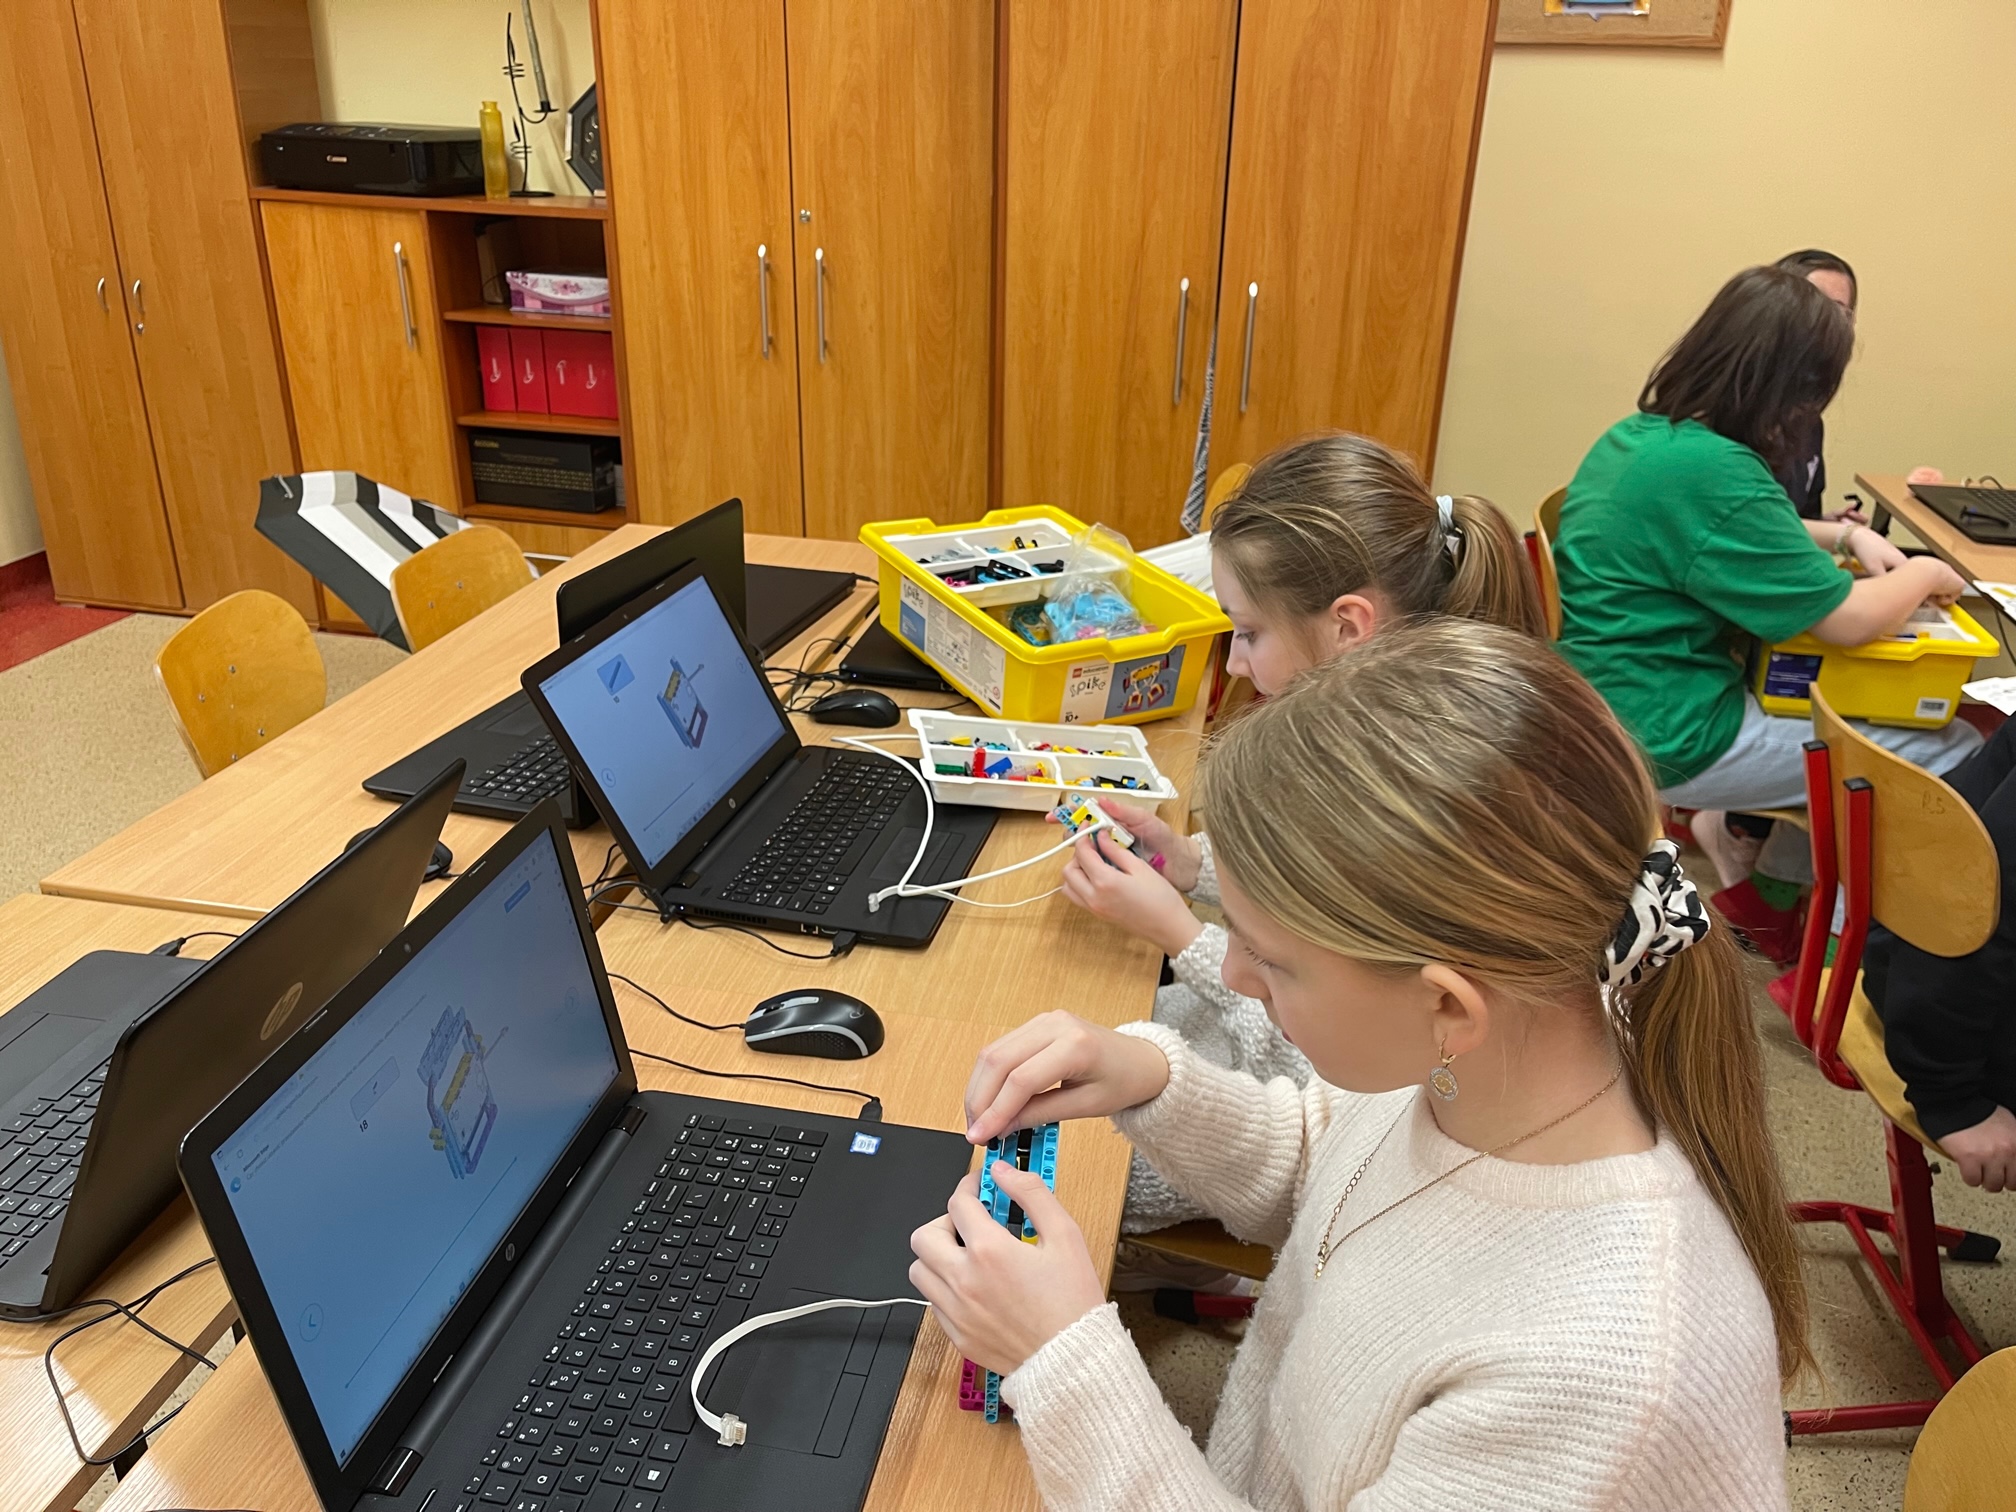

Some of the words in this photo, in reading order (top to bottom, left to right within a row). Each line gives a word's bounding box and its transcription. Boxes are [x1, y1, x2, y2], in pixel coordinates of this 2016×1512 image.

[692, 1311, 702, 1319] M
[680, 1334, 691, 1342] N
[632, 1366, 642, 1374] G
[655, 1383, 665, 1391] V
[643, 1410, 653, 1418] C
[568, 1419, 579, 1427] E
[603, 1418, 614, 1426] D
[628, 1437, 640, 1445] X
[552, 1445, 563, 1456] W
[537, 1475, 548, 1484] Q
[574, 1475, 585, 1483] A
